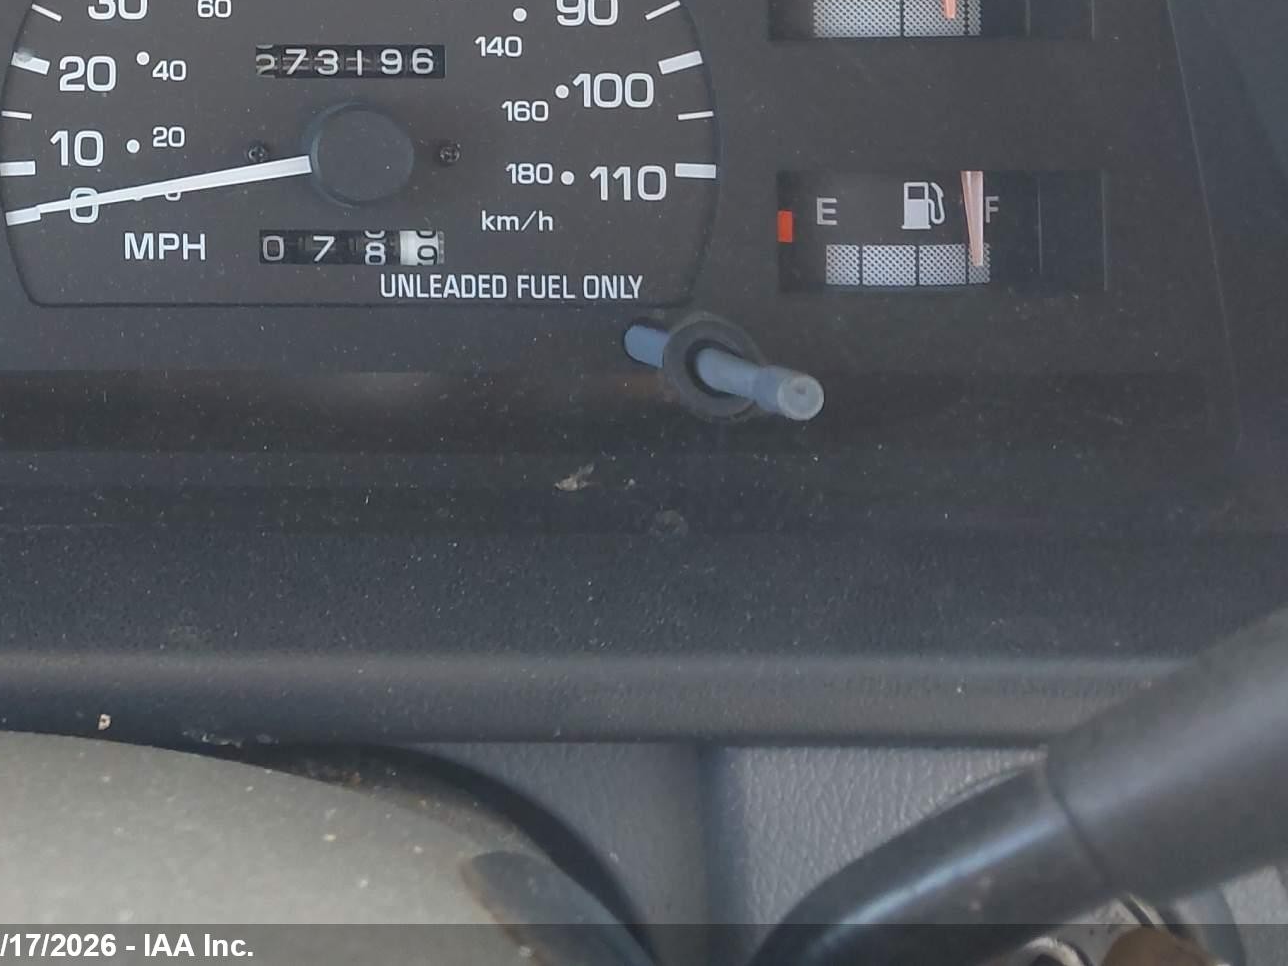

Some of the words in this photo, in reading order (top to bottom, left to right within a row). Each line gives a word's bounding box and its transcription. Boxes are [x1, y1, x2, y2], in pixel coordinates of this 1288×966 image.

[474, 36, 523, 57] 140
[59, 55, 117, 92] 20
[151, 60, 187, 81] 40
[572, 72, 655, 109] 100
[501, 100, 549, 122] 160
[50, 130, 104, 167] 10
[152, 126, 185, 148] 20
[506, 163, 553, 184] 180
[589, 165, 667, 201] 110
[69, 186, 100, 224] 0
[816, 197, 838, 226] E
[481, 210, 553, 231] km/h
[124, 232, 206, 260] MPH
[380, 273, 507, 299] UNLEADED
[517, 274, 576, 299] FUEL
[583, 275, 643, 299] ONLY
